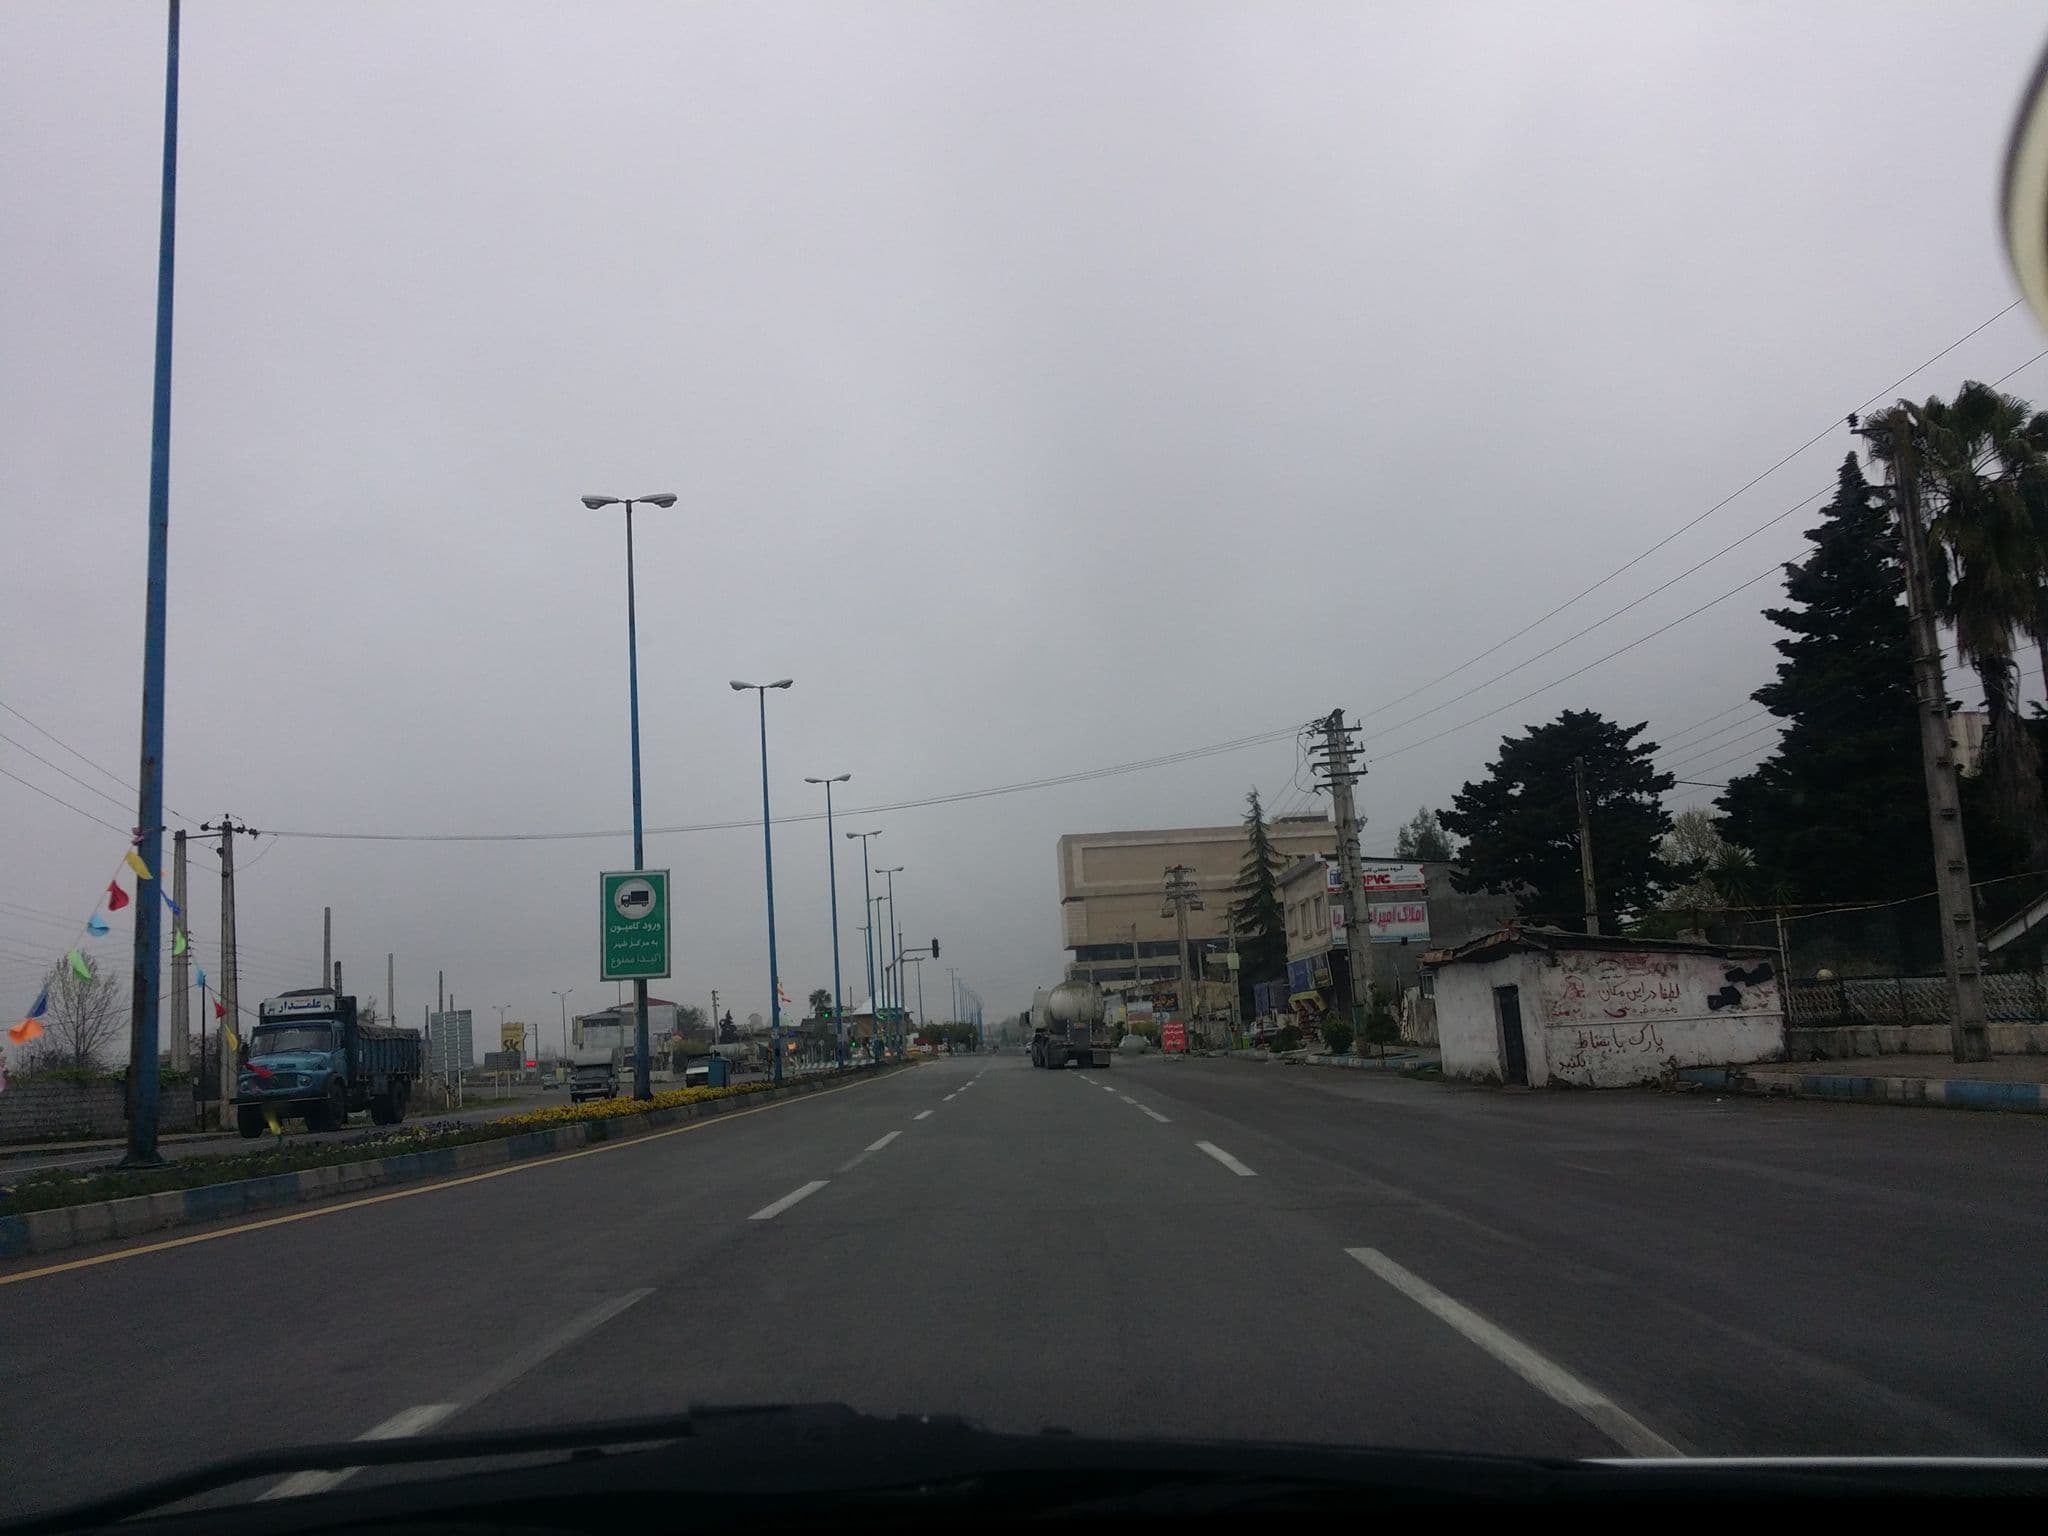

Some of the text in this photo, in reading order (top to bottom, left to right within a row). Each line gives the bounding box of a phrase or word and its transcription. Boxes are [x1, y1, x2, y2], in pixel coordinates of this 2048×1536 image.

[1397, 905, 1426, 922] املاک
[609, 921, 662, 934] ورود کامیون
[612, 937, 659, 950] به مرکز شهر
[610, 956, 636, 969] ممنوع
[1598, 979, 1630, 1002] مکان
[1626, 982, 1645, 1002] این
[1641, 990, 1657, 1003] در
[1659, 982, 1680, 1002] لطفا
[278, 999, 321, 1013] علمدار
[1612, 1027, 1627, 1054] یا
[1629, 1022, 1665, 1055] پارک
[1557, 1050, 1586, 1076] نکنید
